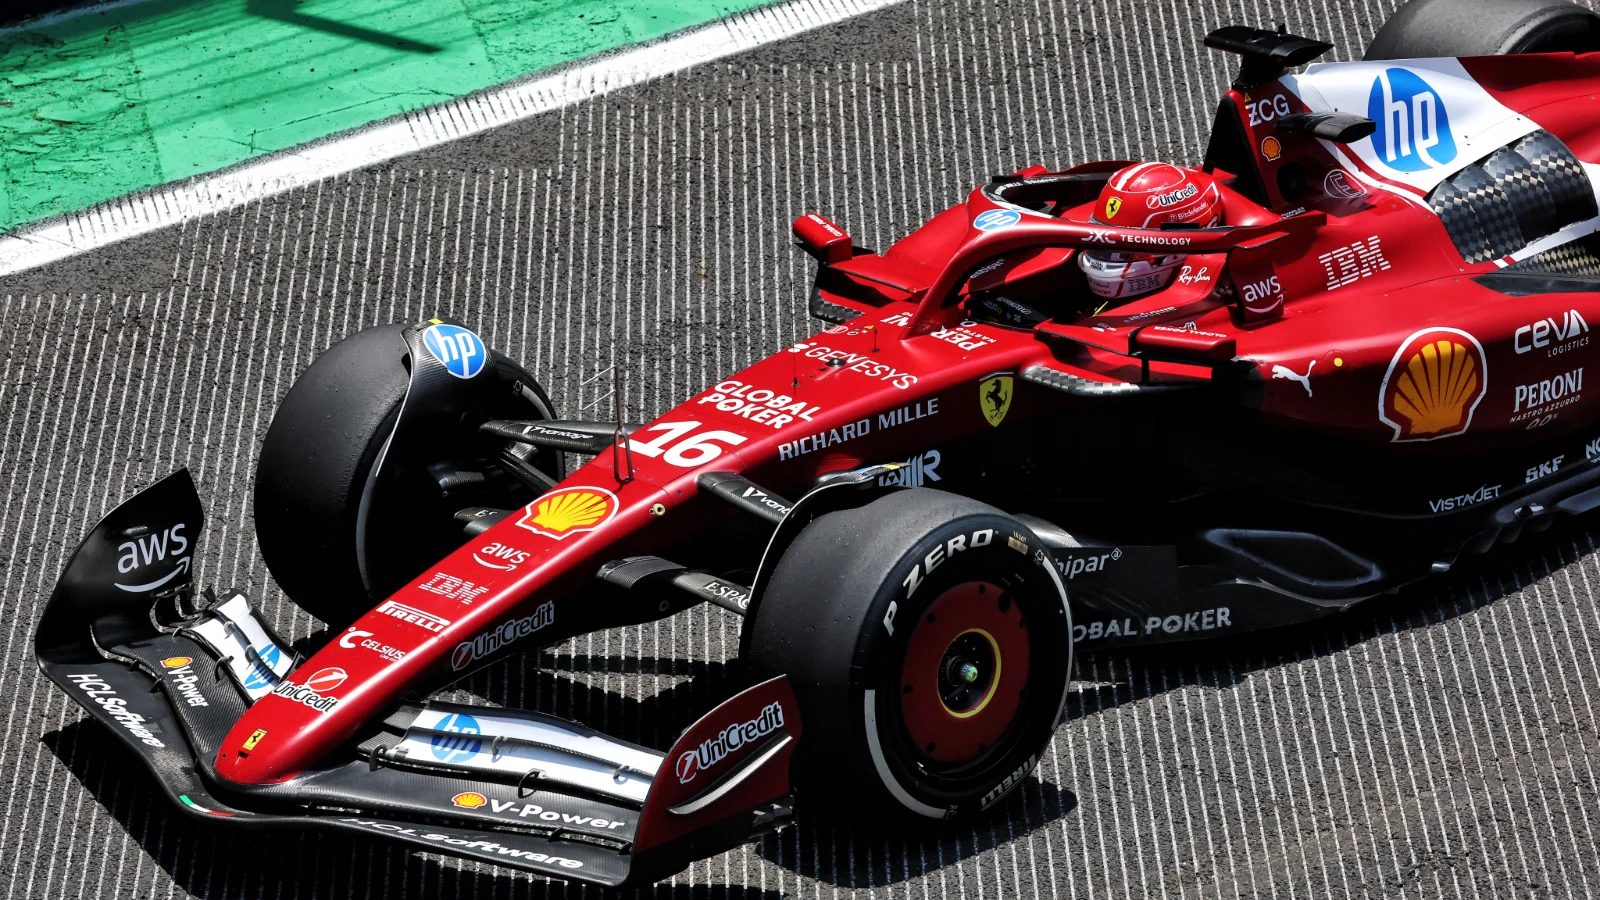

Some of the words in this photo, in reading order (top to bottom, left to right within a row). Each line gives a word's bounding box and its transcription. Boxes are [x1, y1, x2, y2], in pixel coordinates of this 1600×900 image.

[1245, 93, 1290, 127] ZCG
[1380, 70, 1446, 167] hp
[1159, 184, 1198, 207] UniCredit
[978, 213, 1018, 229] hp
[1120, 234, 1192, 246] TECHNOLOGY
[1318, 235, 1391, 291] IBM
[1128, 274, 1160, 293] IBM
[1242, 275, 1281, 303] aws
[429, 327, 477, 378] hp
[961, 327, 997, 344] NASTRO
[1547, 336, 1590, 358] LOGISTICS
[804, 346, 918, 390] GENESYS
[713, 380, 823, 422] GLOBAL
[1513, 367, 1584, 413] PERONI
[697, 392, 794, 429] POKER
[1509, 408, 1544, 424] NASTRO
[1543, 394, 1581, 413] AZZURRO
[617, 419, 748, 468] 16
[778, 418, 871, 462] RICHARD
[878, 398, 939, 431] MILLE
[1525, 454, 1565, 484] SKF
[1429, 483, 1502, 513] VISTAJET
[117, 523, 188, 574] aws
[481, 542, 531, 565] aws
[418, 572, 489, 605] IBM
[883, 600, 898, 637] P
[903, 528, 994, 599] ZERO
[376, 600, 451, 632] PIRELLI
[472, 600, 555, 660] UniCredit
[1073, 619, 1138, 643] OBAL
[1145, 607, 1232, 634] POKER
[360, 637, 407, 660] CELSIUS
[168, 667, 209, 708] V-Power
[272, 681, 338, 713] UniCredit
[67, 674, 165, 749] HCLSoftware
[697, 700, 785, 770] UniCredit
[980, 754, 1036, 808] IRELLI
[490, 798, 625, 830] V-Power
[339, 818, 584, 869] HCLSoftware
